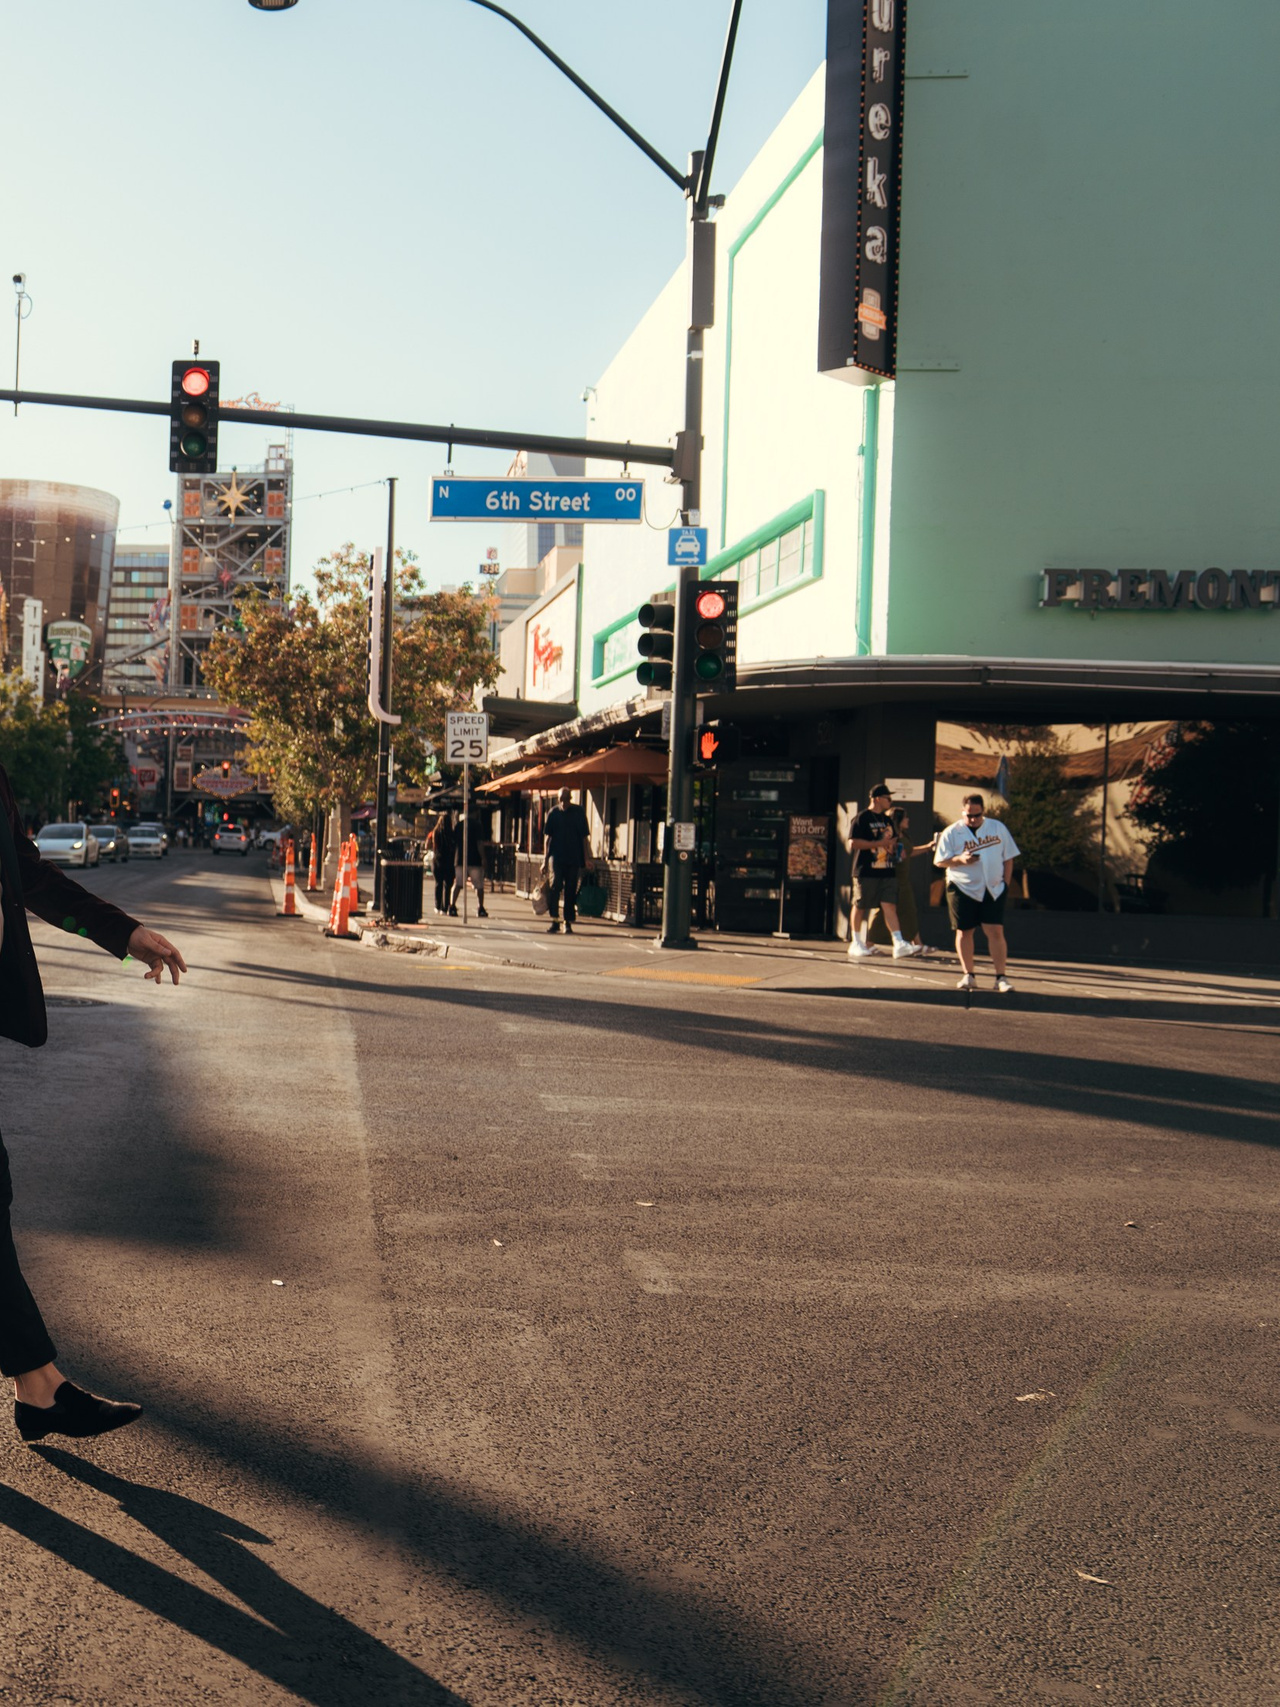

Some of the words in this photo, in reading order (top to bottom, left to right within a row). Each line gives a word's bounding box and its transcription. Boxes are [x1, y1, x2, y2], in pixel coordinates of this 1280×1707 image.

[439, 485, 449, 499] N
[485, 490, 520, 511] 6th
[529, 490, 591, 512] Street
[450, 716, 484, 725] SPEED
[453, 728, 480, 736] LIMIT
[450, 740, 483, 758] 25
[792, 817, 813, 826] Want
[791, 826, 806, 834] $10
[807, 826, 825, 834] Off?
